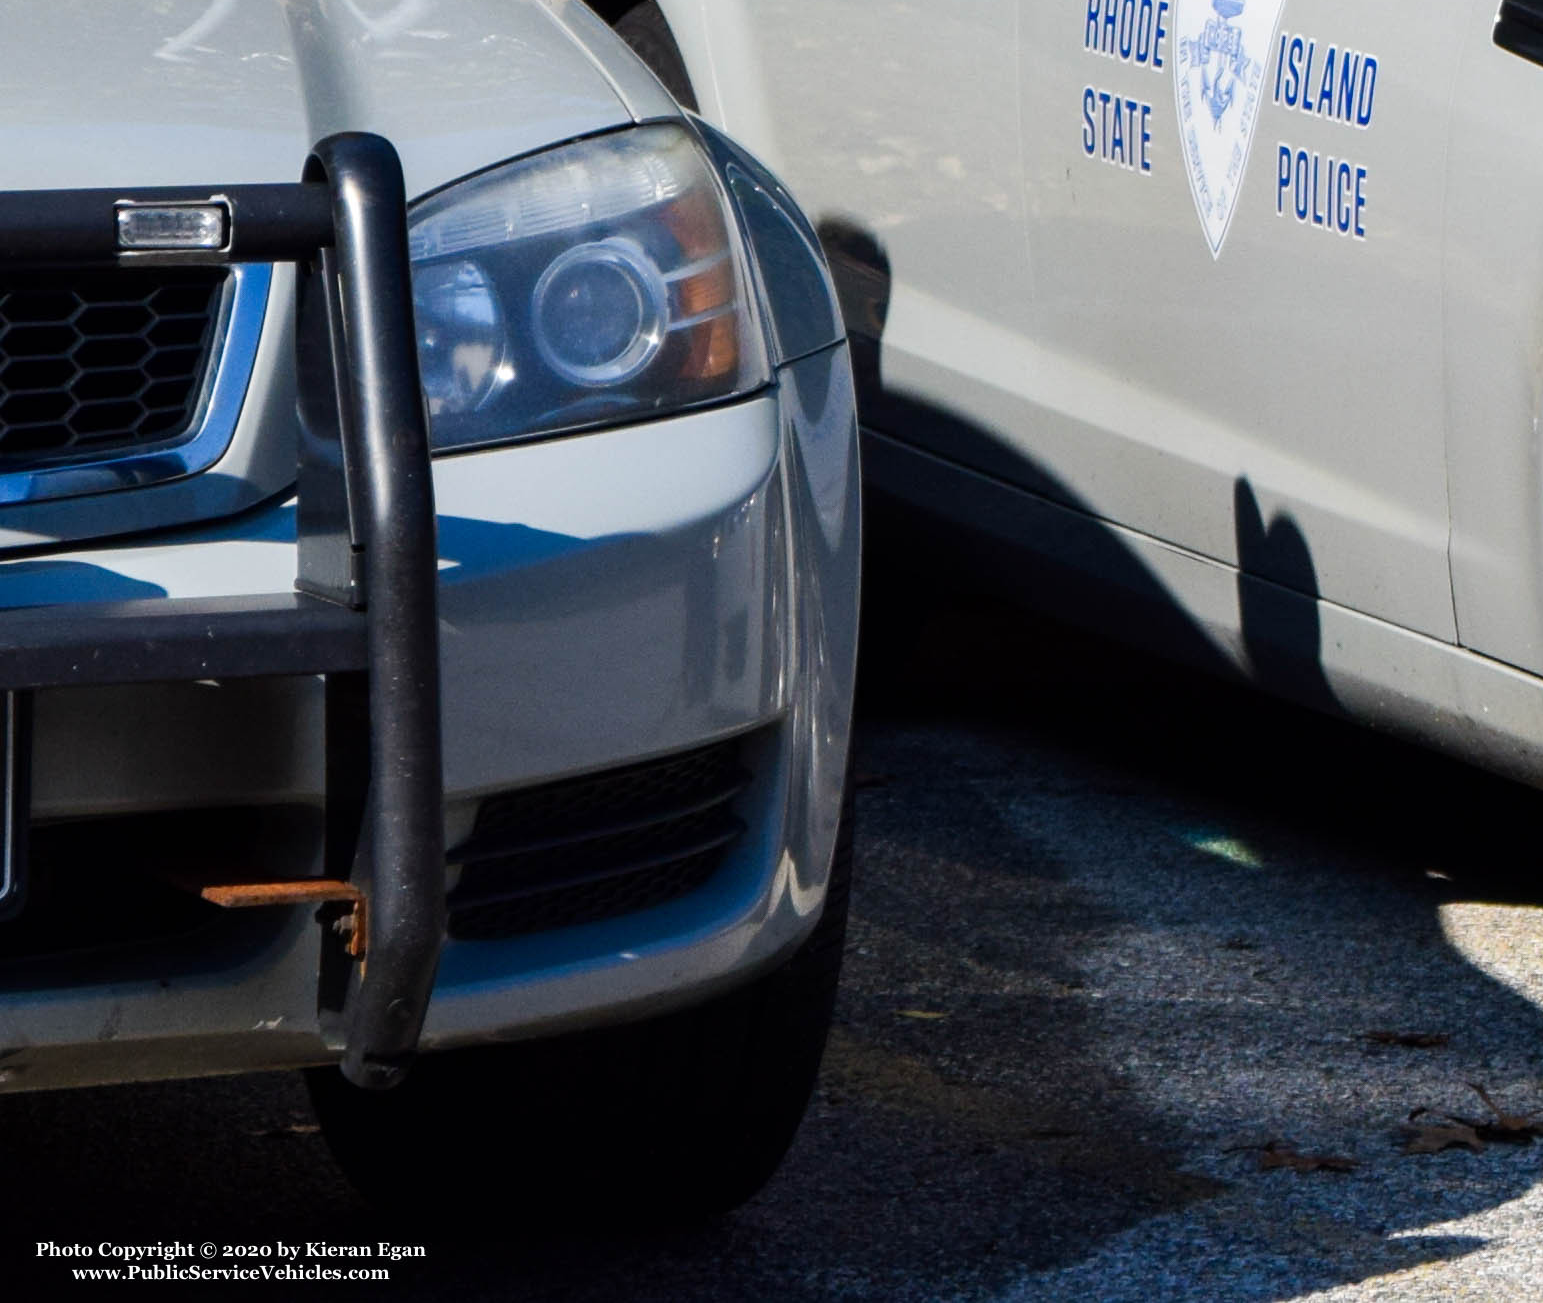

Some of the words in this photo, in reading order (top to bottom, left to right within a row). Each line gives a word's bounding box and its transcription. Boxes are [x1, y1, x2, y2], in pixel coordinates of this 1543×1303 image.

[1274, 34, 1379, 128] ISLAND
[1082, 87, 1153, 172] STATE
[1277, 144, 1368, 238] POLICE
